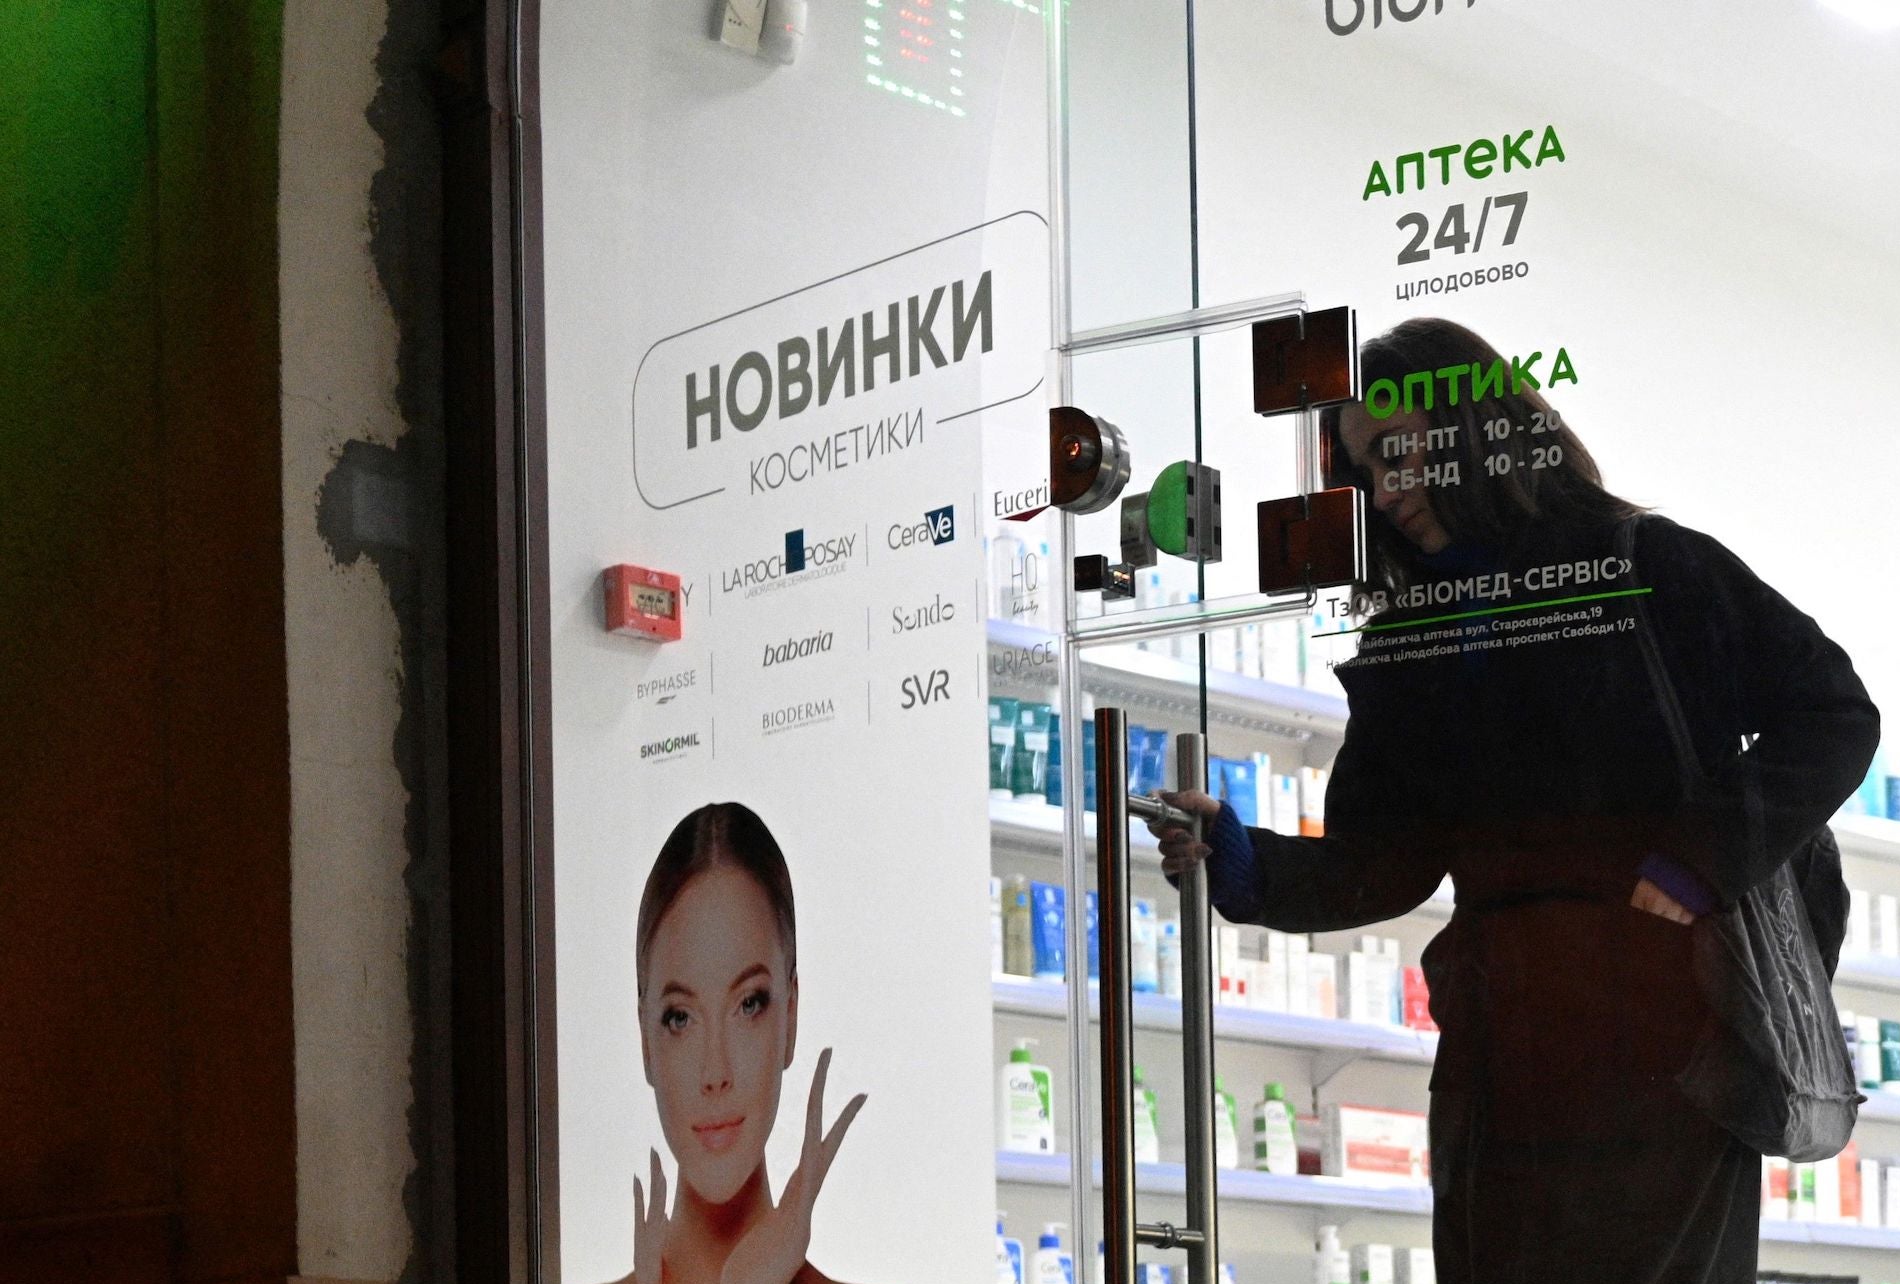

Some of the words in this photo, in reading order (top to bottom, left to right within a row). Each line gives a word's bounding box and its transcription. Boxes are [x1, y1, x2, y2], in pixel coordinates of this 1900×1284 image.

[1395, 191, 1529, 266] 24/7
[1396, 261, 1529, 301] ЦІЛОДОБОВО
[686, 270, 993, 450] НОВИНКИ
[1365, 347, 1578, 420] ОПТИКА
[749, 407, 924, 495] КОСМЕТИКИ
[1382, 426, 1459, 458] ПН-ПТ
[1483, 417, 1511, 442] 10
[1530, 410, 1561, 435] 20
[1382, 460, 1461, 493] СБ-НД
[1484, 453, 1512, 477] 10
[1531, 445, 1563, 470] 20
[994, 479, 1048, 517] Euceri
[803, 533, 856, 566] POSAY
[888, 507, 954, 550] CeraVe
[1394, 556, 1633, 609] «БІОМЕД-СЕРВІС»
[762, 630, 834, 668] babaria
[992, 640, 1054, 676] URIAGE
[1356, 632, 1420, 651] Найближча
[1423, 625, 1463, 641] аптека
[1466, 623, 1489, 639] вул.
[1393, 645, 1460, 663] цілодобова
[1462, 637, 1503, 652] аптека
[1505, 631, 1560, 648] проспект
[1562, 623, 1615, 639] Свободи
[1617, 617, 1636, 633] 1/3
[637, 669, 697, 700] BYPHASSE
[900, 669, 950, 710] SVR
[762, 698, 835, 730] BIODERMA
